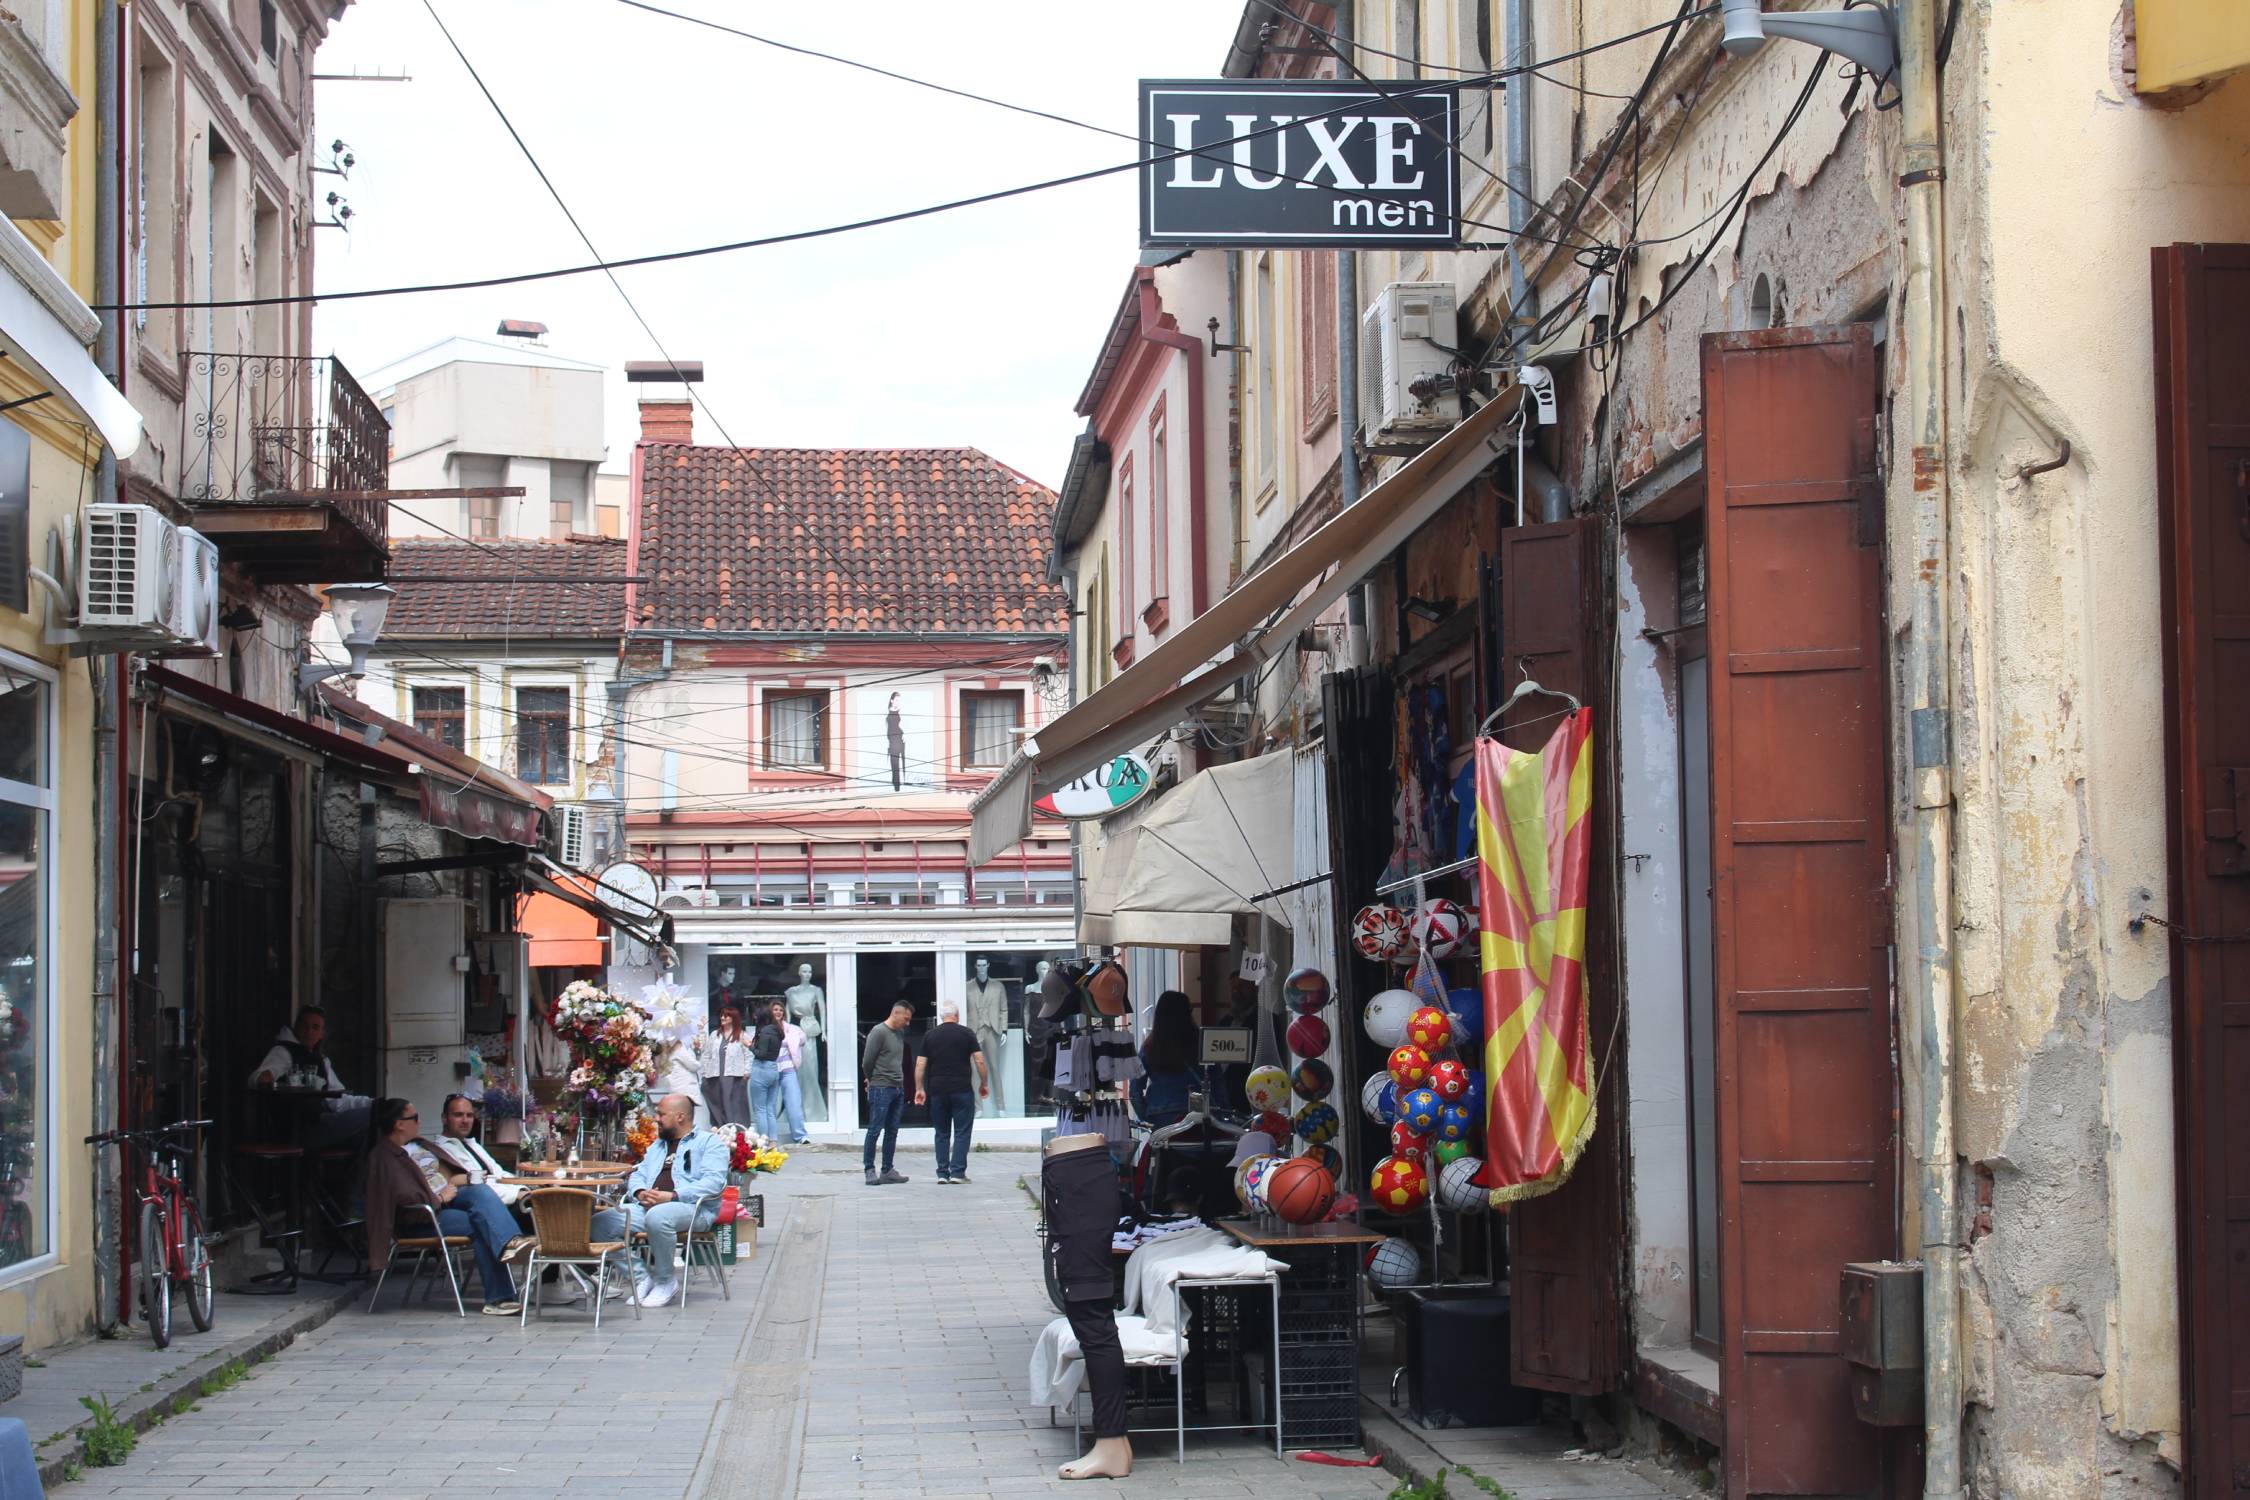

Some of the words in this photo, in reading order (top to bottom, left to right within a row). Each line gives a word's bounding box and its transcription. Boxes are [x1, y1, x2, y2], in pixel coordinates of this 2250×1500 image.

[1166, 114, 1425, 190] LUXE
[1332, 199, 1435, 226] men
[1211, 1039, 1235, 1052] 500
